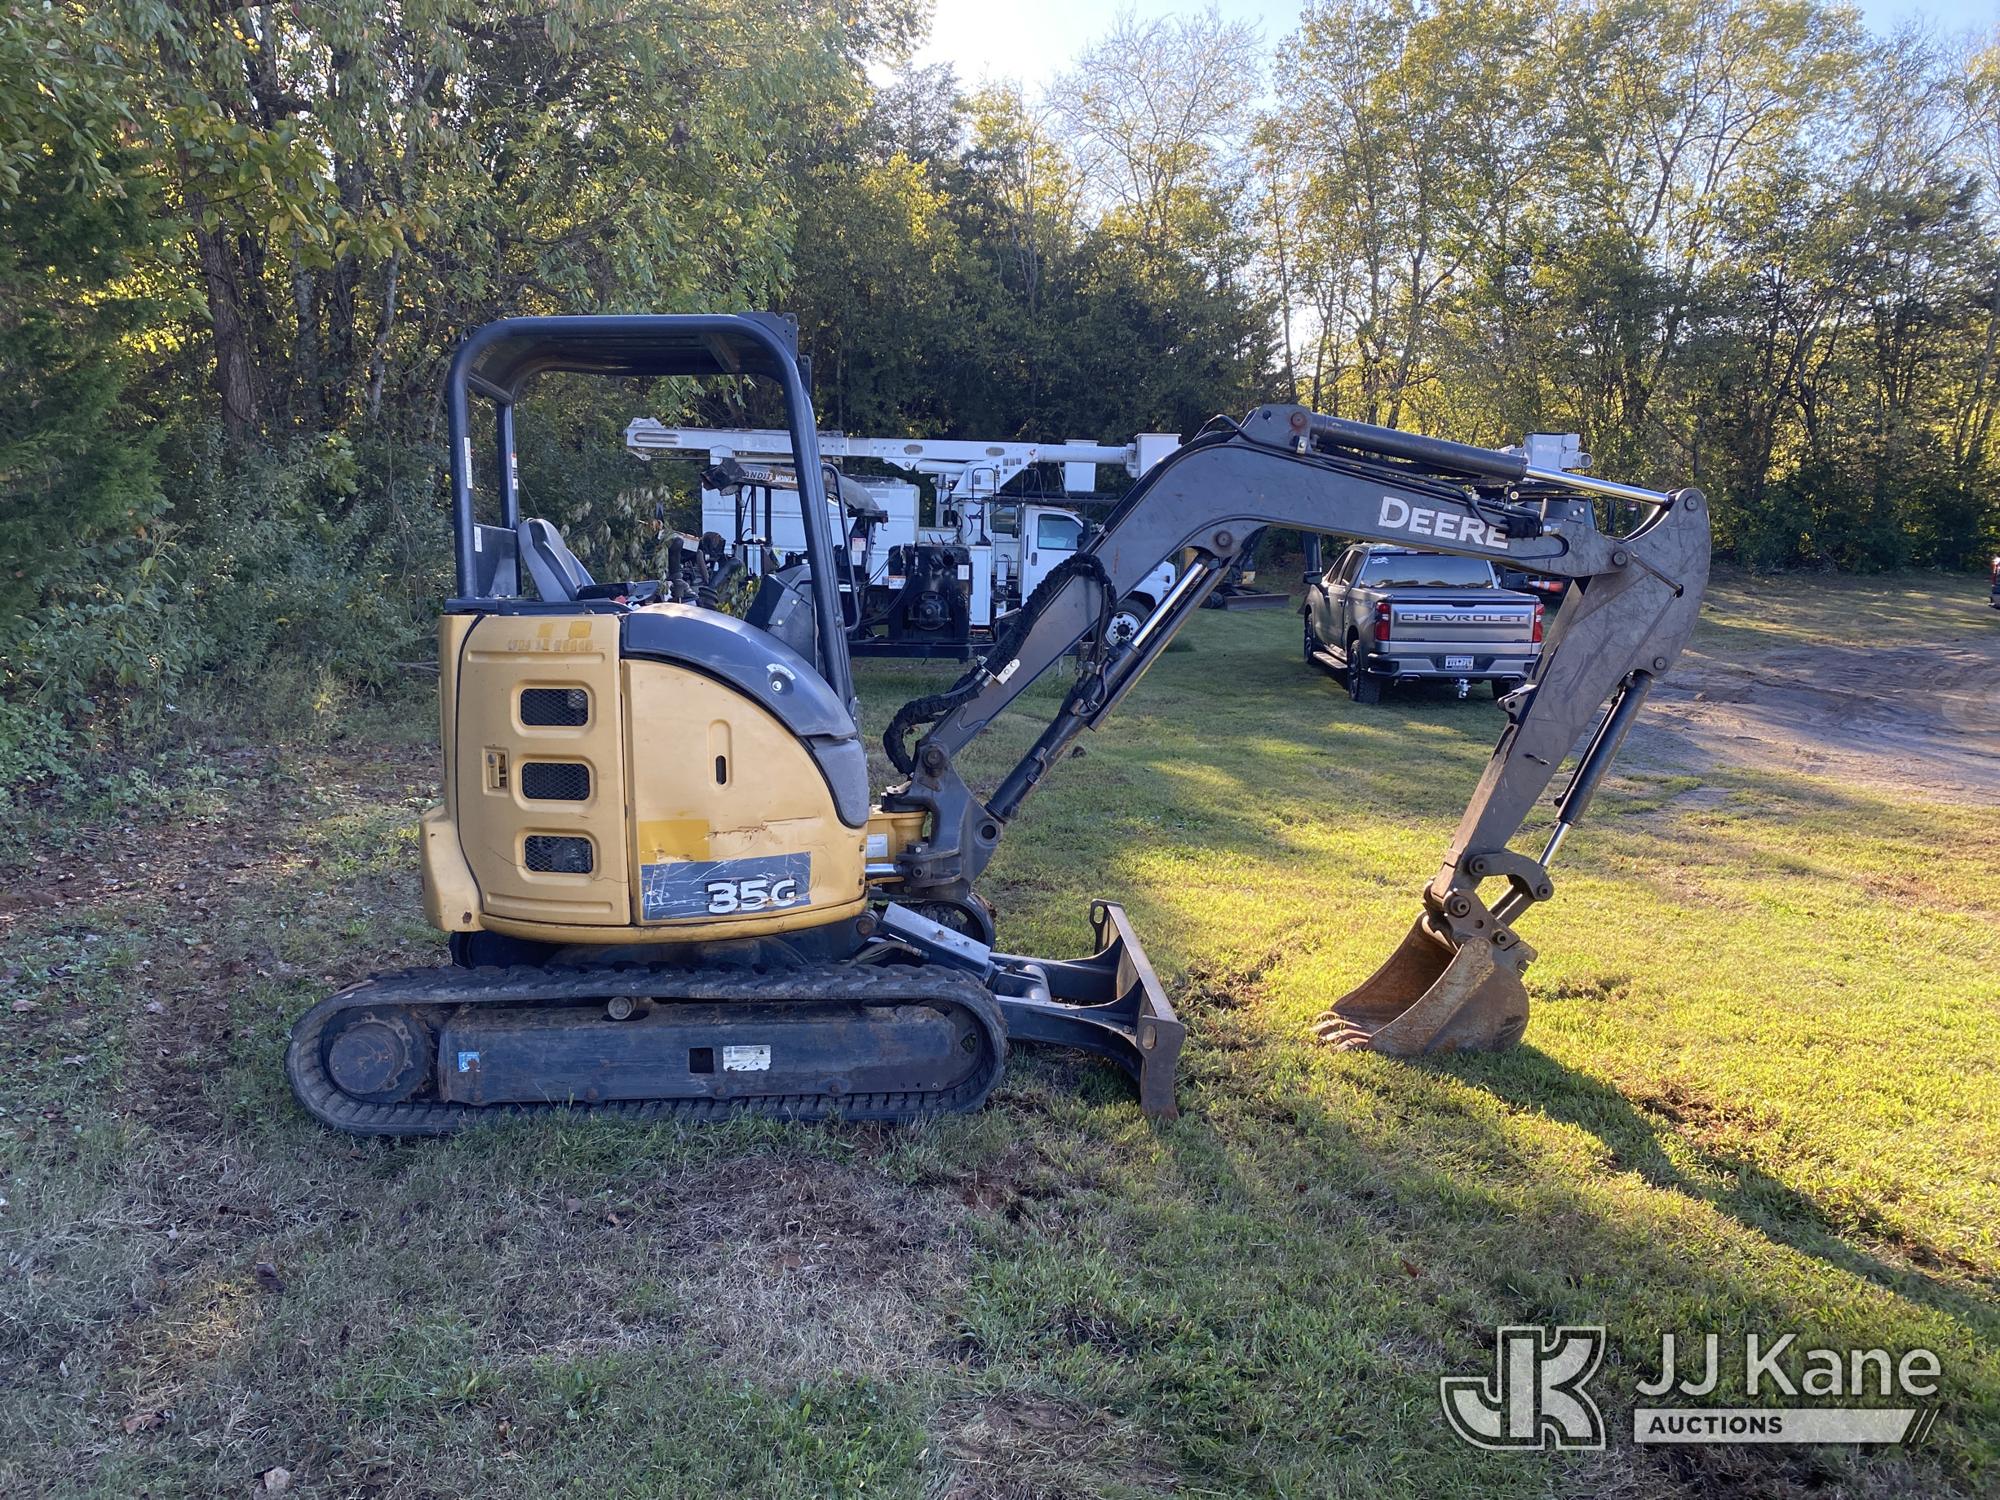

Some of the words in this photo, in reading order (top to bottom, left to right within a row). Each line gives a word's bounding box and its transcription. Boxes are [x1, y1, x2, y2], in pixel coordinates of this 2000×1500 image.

[744, 470, 772, 481] ANDIT
[1378, 496, 1509, 549] DEERE
[1401, 614, 1525, 622] CHEVROLET
[707, 878, 796, 914] 35G
